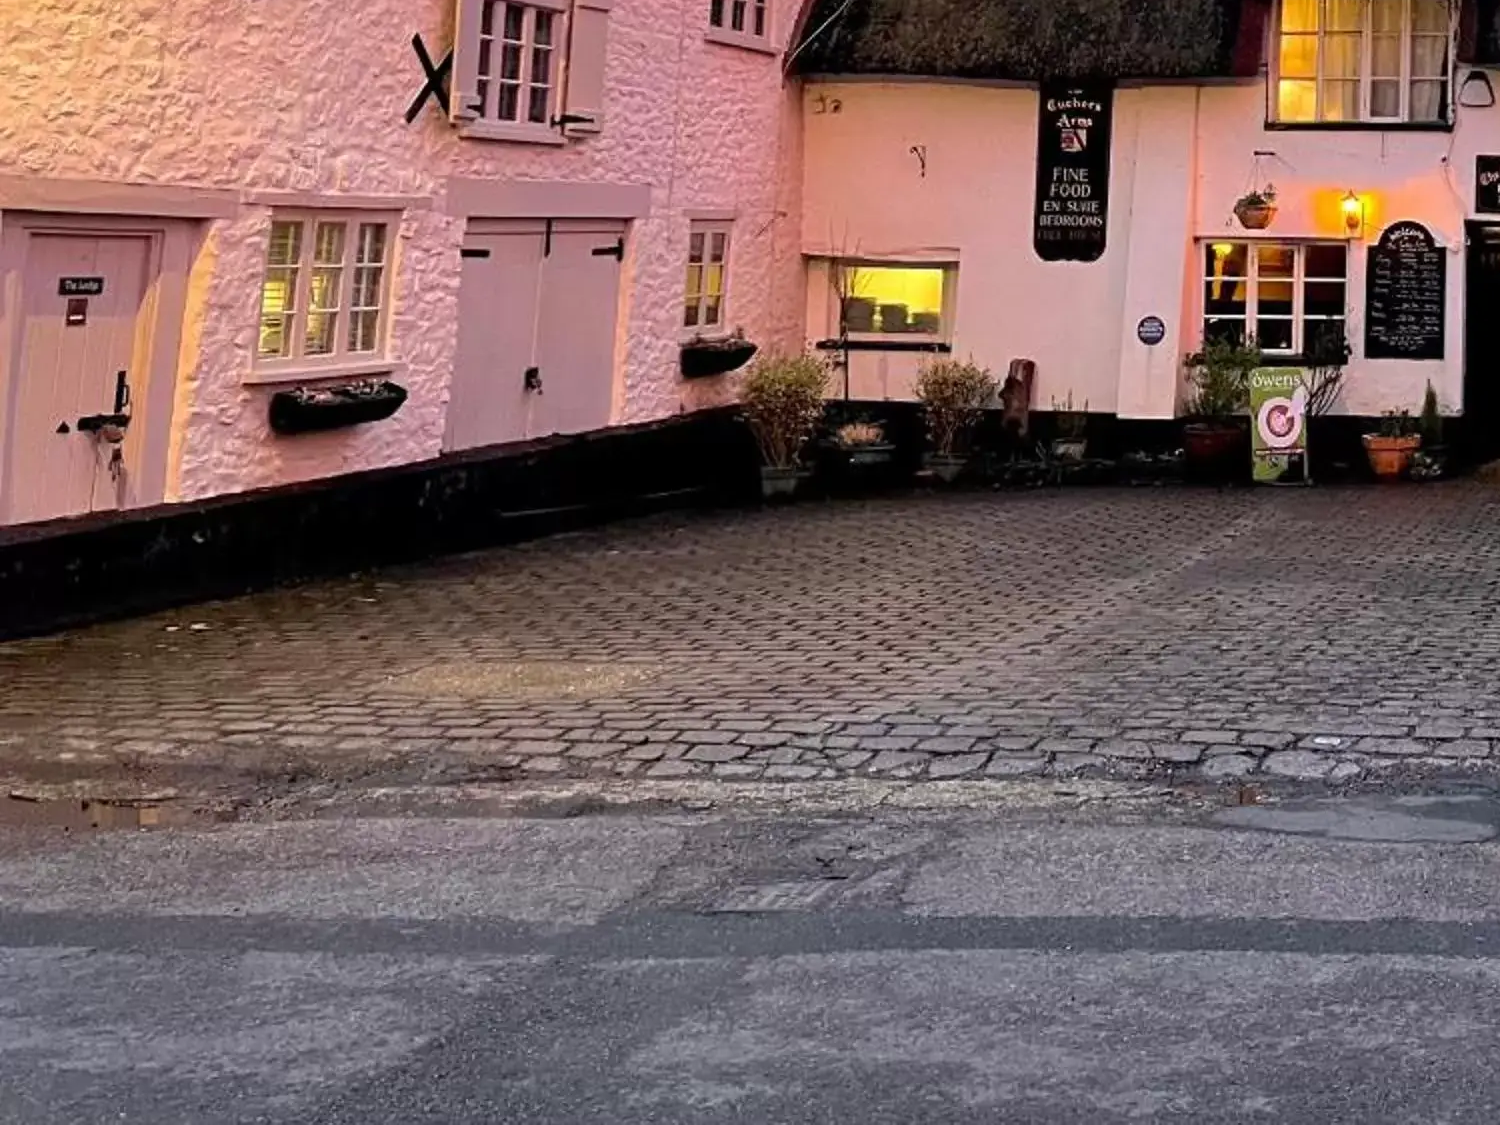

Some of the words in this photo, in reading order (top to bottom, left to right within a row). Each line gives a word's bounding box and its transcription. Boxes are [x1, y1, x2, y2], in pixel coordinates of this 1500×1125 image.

[1056, 113, 1093, 128] Arms
[1052, 166, 1089, 182] FINE
[1050, 182, 1091, 198] FOOD
[1043, 200, 1060, 212] EN
[1039, 214, 1103, 228] BEDROOMS
